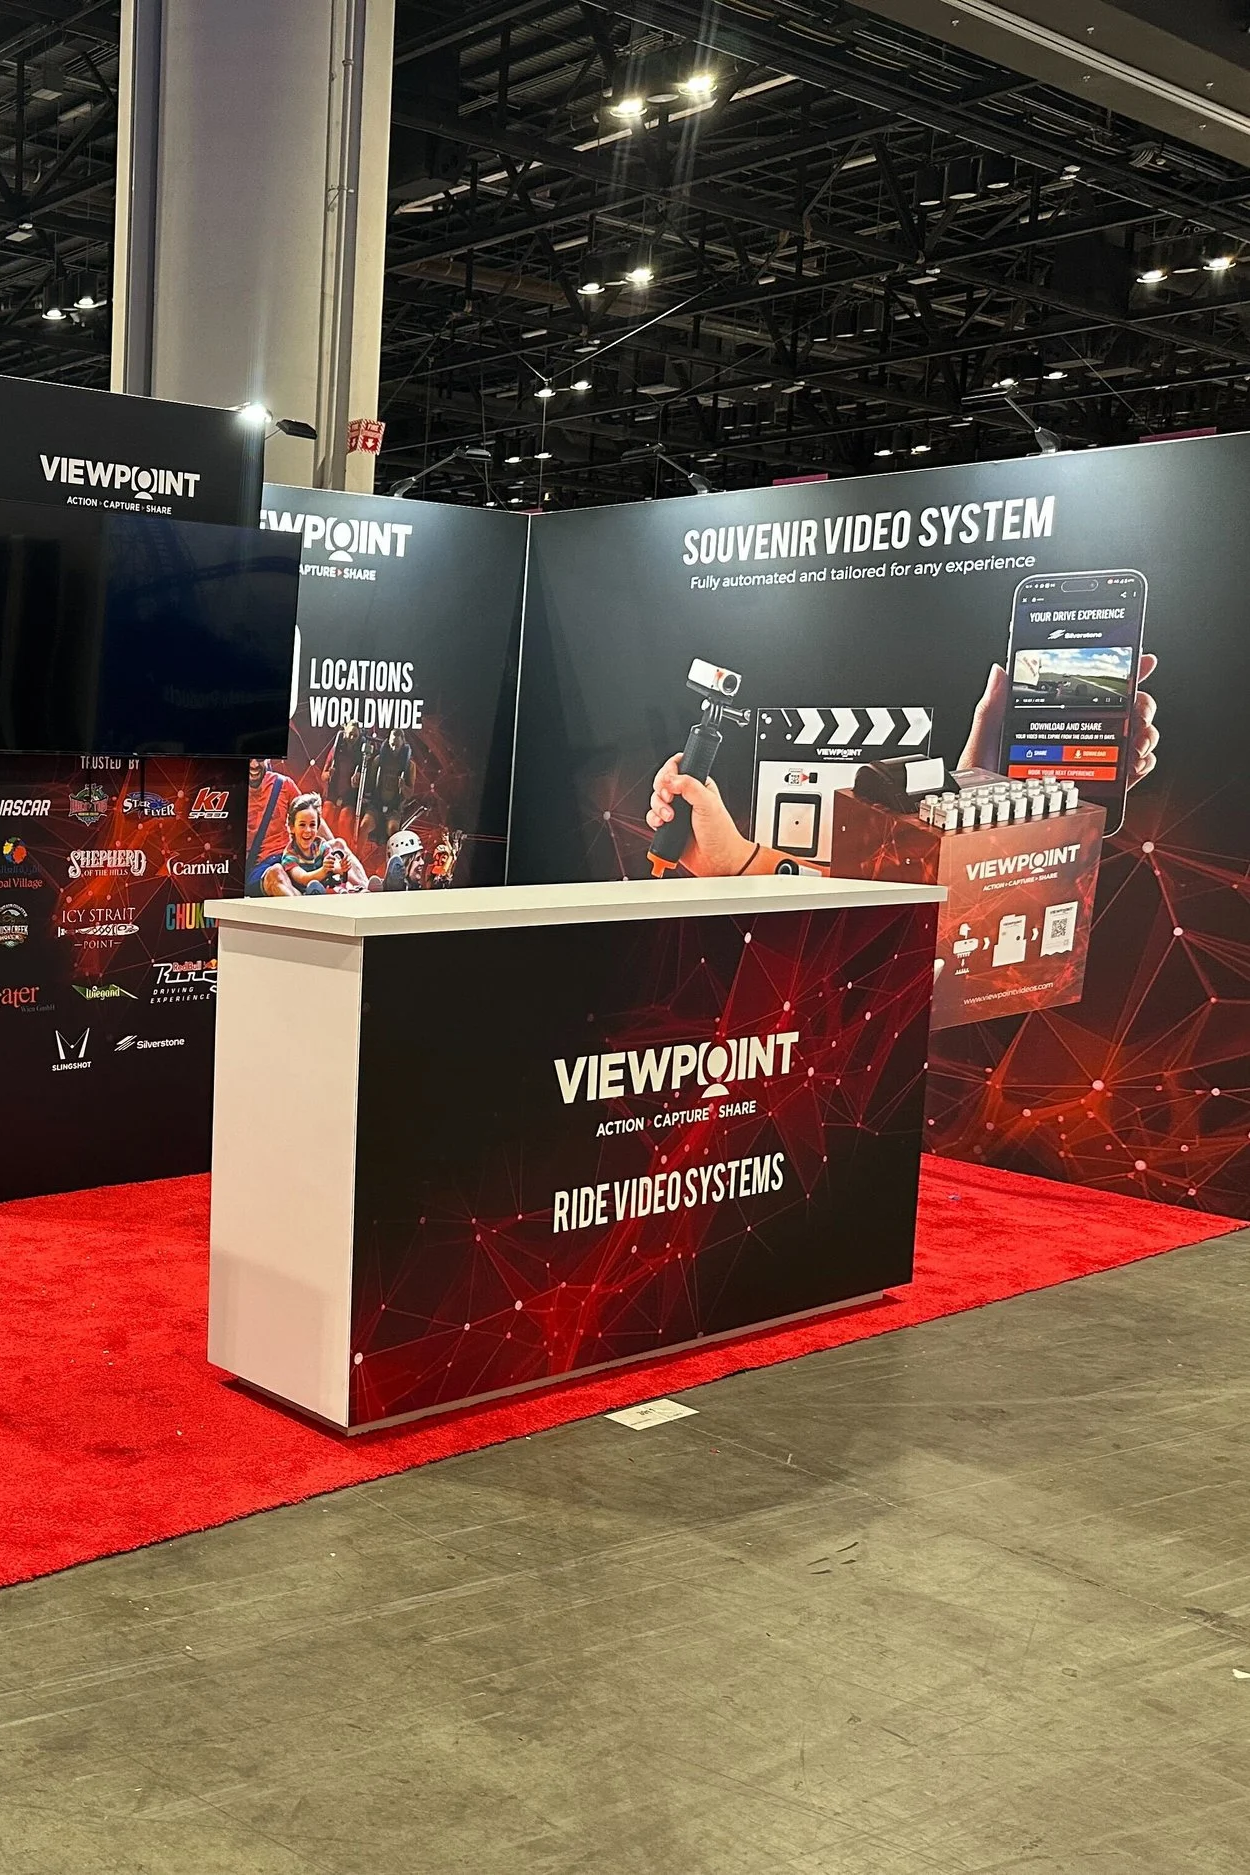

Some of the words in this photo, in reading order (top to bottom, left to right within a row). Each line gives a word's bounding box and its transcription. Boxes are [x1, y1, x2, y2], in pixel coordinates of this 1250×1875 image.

[39, 454, 201, 500] VIEWPOINT
[67, 496, 98, 507] ACTION
[103, 500, 140, 511] CAPTURE
[145, 504, 172, 515] SHARE
[259, 509, 412, 562] WPOINT
[683, 517, 817, 566] SOUVENIR
[823, 510, 911, 555] VIDEO
[918, 495, 1055, 548] SYSTEM
[299, 563, 337, 578] APTURE
[343, 567, 376, 581] SHARE
[690, 574, 721, 590] Fully
[722, 570, 796, 588] automated
[799, 568, 827, 583] and
[830, 563, 886, 581] tailored
[890, 561, 912, 577] for
[913, 562, 942, 578] any
[945, 555, 1035, 577] experience
[1030, 610, 1051, 623] YOUR
[1053, 609, 1076, 622] DRIVE
[1078, 608, 1125, 620] EXPERIENCE
[309, 657, 414, 693] LOCATIONS
[309, 696, 424, 730] WORLDWIDE
[1030, 723, 1065, 731] DOWNLOAD
[1081, 722, 1102, 731] SHARE
[816, 748, 862, 758] VIEWPOINT
[80, 756, 121, 769] TRUSTED
[128, 759, 140, 770] BY
[191, 787, 229, 811] K1
[144, 803, 176, 816] FLYER
[188, 811, 229, 819] SPEED
[68, 849, 147, 879] SHEPHERD
[171, 860, 229, 876] Carnival
[966, 844, 1081, 881] VIEWPOINT
[84, 869, 94, 877] OF
[12, 877, 43, 890] Village
[983, 881, 1005, 892] ACTION
[1008, 876, 1035, 888] CAPTURE
[1038, 872, 1058, 882] SHARE
[62, 909, 85, 923] ICY
[89, 907, 136, 922] STRAIT
[166, 903, 220, 930] CHUK
[83, 940, 114, 949] POINT
[86, 986, 120, 1000] Wiegand
[150, 993, 210, 1004] EXPERIENCE
[153, 986, 194, 995] DRIVING
[136, 1037, 185, 1049] Silverstone
[52, 1061, 92, 1072] SLINGSHOT
[553, 1031, 799, 1104] VIEWPOINT
[596, 1117, 644, 1138] ACTION
[653, 1107, 710, 1128] CAPTURE
[718, 1100, 757, 1118] SHARE
[553, 1183, 610, 1234] RIDE
[613, 1170, 681, 1222] VIDEO
[684, 1152, 785, 1208] SYSTEMS
